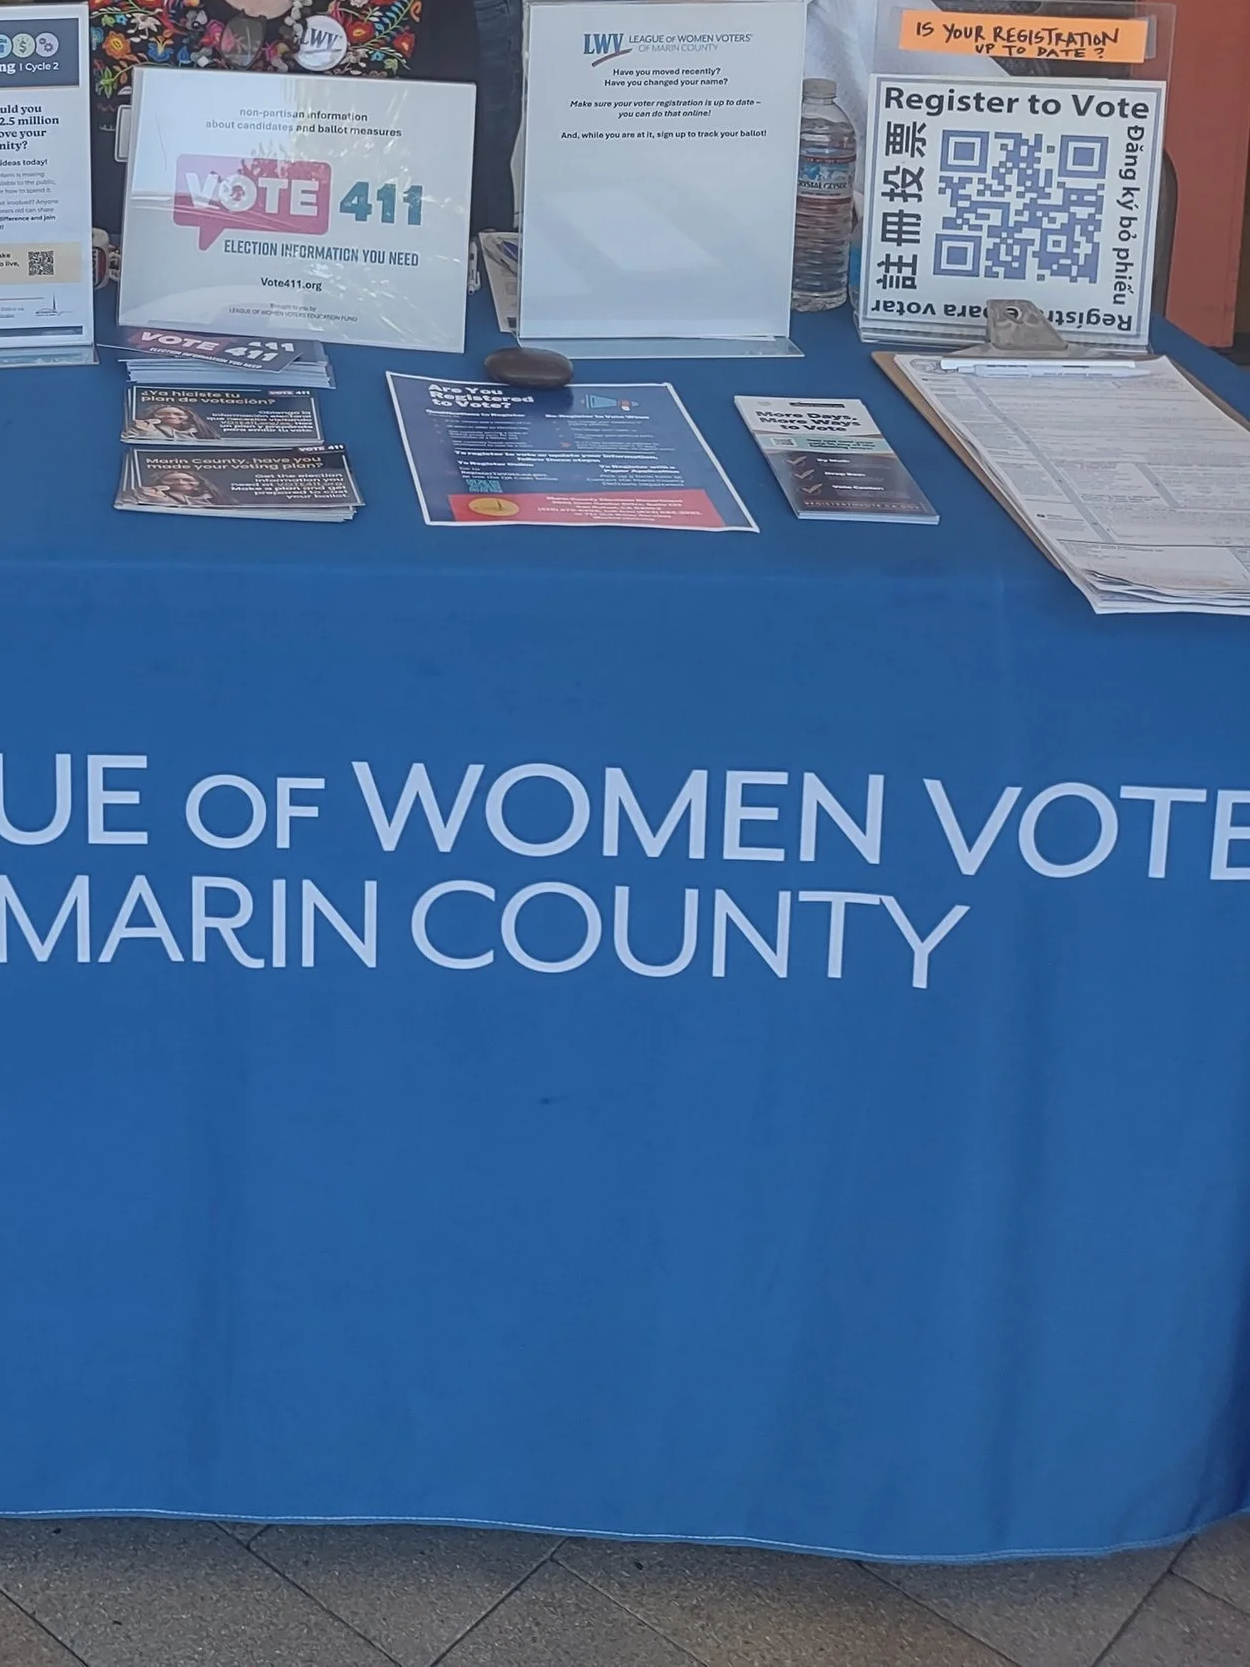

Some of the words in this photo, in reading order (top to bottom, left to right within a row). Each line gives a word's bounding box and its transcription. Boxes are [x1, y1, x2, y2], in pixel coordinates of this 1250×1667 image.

[301, 28, 341, 51] LWV
[629, 34, 664, 43] LEAGUE
[677, 34, 713, 42] WOMEN
[715, 33, 751, 42] VOTERS
[916, 22, 934, 37] IS
[943, 23, 984, 43] YOUR
[993, 26, 1119, 47] REGISTRATION
[583, 33, 624, 55] LWV
[975, 44, 995, 55] UP
[1003, 45, 1026, 56] TO
[25, 62, 51, 72] Cycle
[53, 62, 59, 72] 2
[612, 68, 633, 76] Have
[635, 69, 650, 77] you
[652, 68, 679, 77] moved
[681, 67, 720, 77] recently?
[643, 78, 678, 87] changed
[20, 106, 41, 115] you
[885, 87, 1019, 116] Register
[1027, 94, 1061, 115] to
[1071, 94, 1149, 119] Vote
[18, 116, 59, 125] million
[239, 109, 304, 118] non-partisan
[307, 110, 367, 121] information
[19, 130, 46, 139] your
[205, 119, 234, 129] about
[237, 122, 293, 134] candidates
[296, 124, 315, 132] and
[318, 124, 347, 134] ballot
[350, 127, 401, 136] measures
[1117, 125, 1145, 182] Đăng
[185, 172, 320, 217] VOTE
[339, 181, 423, 226] 411
[1116, 186, 1142, 211] ký
[224, 239, 277, 256] ELECTION
[281, 243, 358, 262] INFORMATION
[362, 249, 385, 264] YOU
[389, 251, 418, 266] NEED
[260, 277, 322, 291] Vote411.org
[871, 299, 936, 316] votar
[141, 331, 220, 351] VOTE
[224, 347, 278, 361] 411
[428, 384, 462, 393] Are
[465, 387, 502, 395] You
[429, 392, 533, 402] Registered
[455, 400, 511, 408] Vote?
[185, 774, 325, 849] OF
[351, 761, 885, 865] WOMEN
[410, 879, 970, 989] COUNTY
